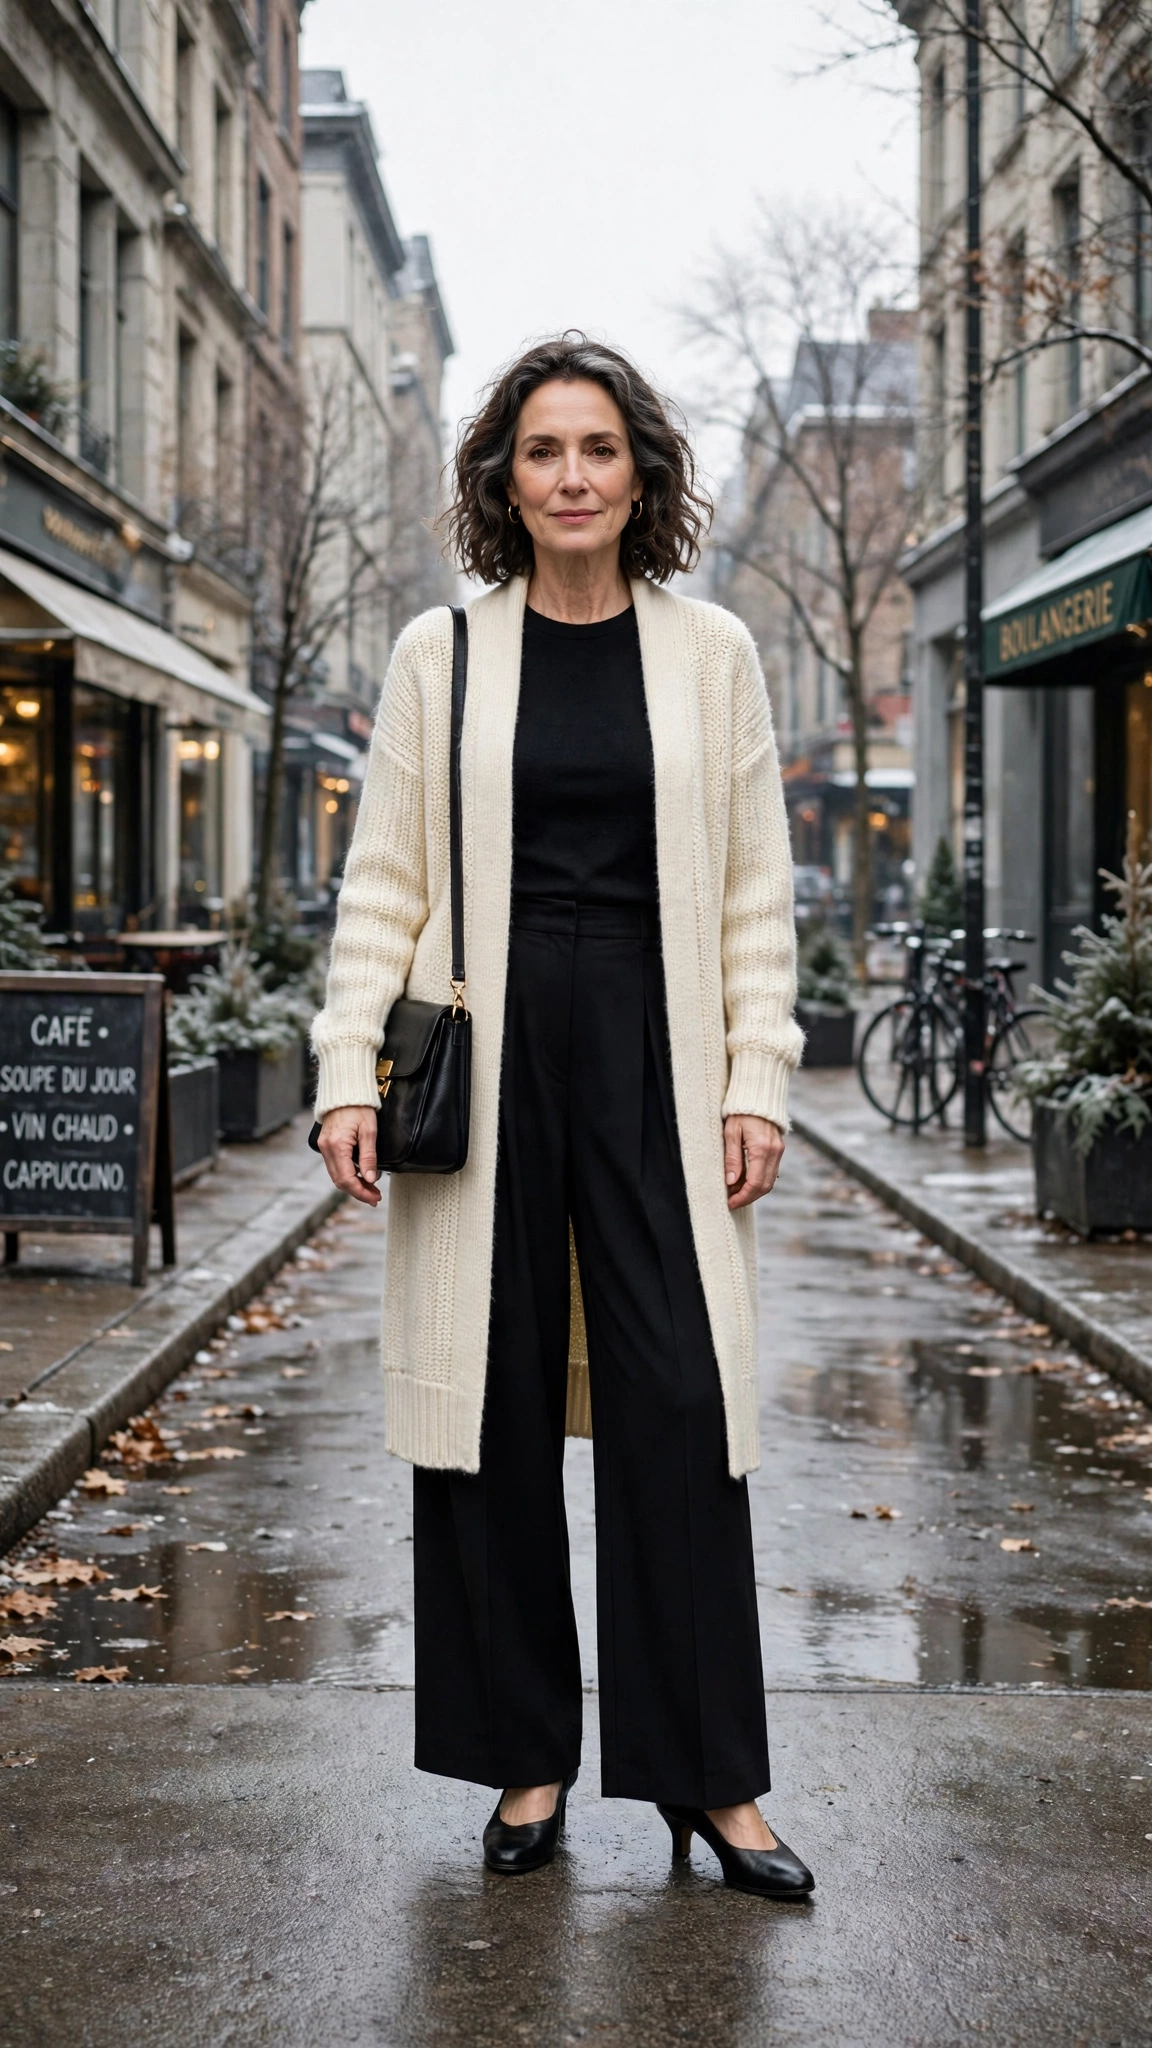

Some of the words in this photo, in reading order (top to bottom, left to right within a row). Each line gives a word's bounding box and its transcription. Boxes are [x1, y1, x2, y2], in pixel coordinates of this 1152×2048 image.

[999, 579, 1114, 661] BOULANGERIE
[0, 1065, 57, 1093] SOUPE
[62, 1066, 87, 1093] DU
[90, 1066, 136, 1095] JOUR
[11, 1112, 46, 1140] VIN
[52, 1113, 118, 1142] CHAUD
[3, 1159, 124, 1191] CAPPUCCINO
